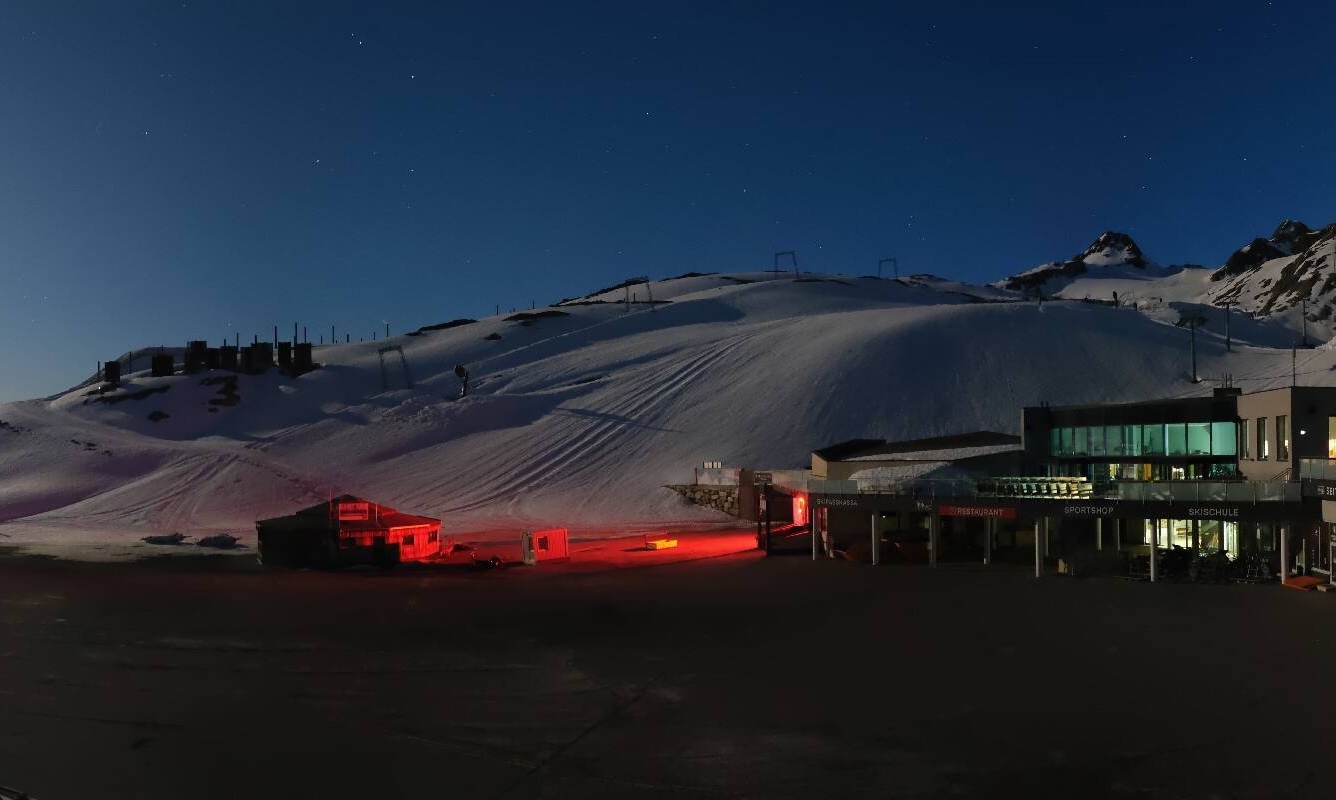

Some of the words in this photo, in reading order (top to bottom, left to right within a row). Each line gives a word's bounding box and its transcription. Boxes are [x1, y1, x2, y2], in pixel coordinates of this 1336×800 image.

[957, 507, 1005, 518] RESTAURANT
[1064, 506, 1114, 515] SPORTSHOP
[1188, 508, 1239, 517] SKISCHULE
